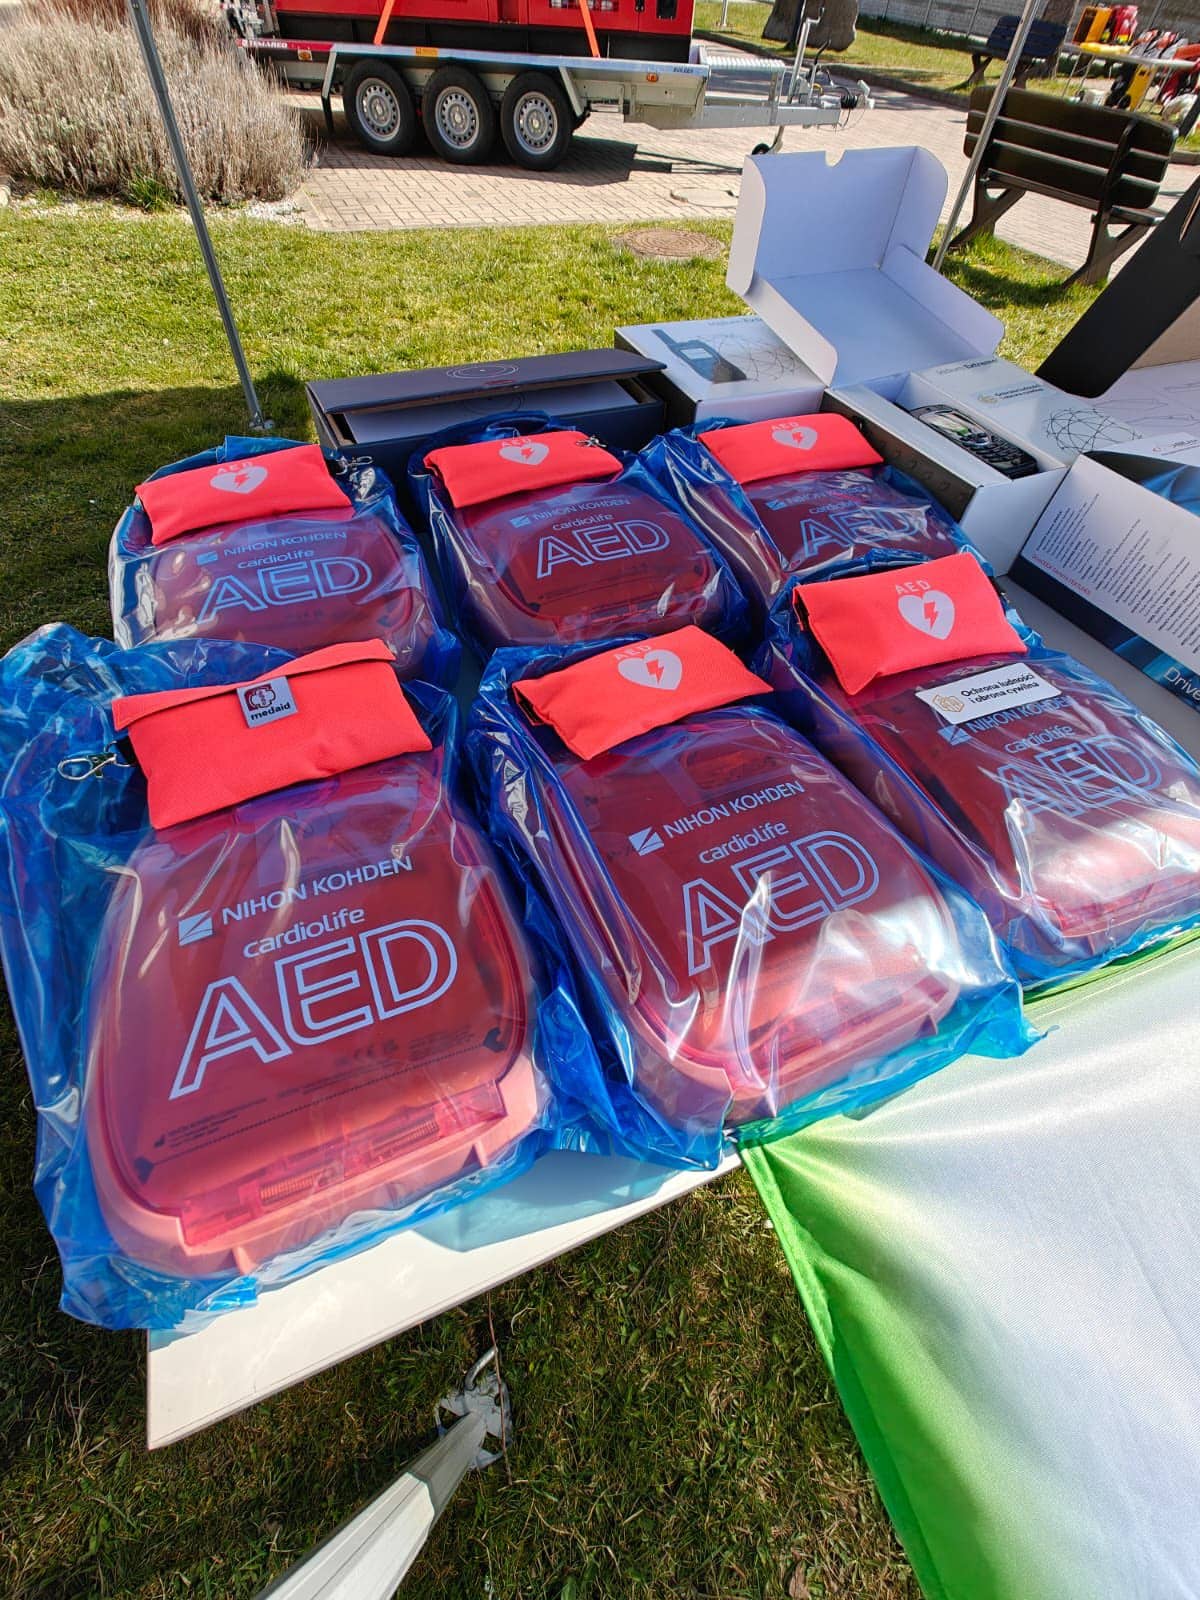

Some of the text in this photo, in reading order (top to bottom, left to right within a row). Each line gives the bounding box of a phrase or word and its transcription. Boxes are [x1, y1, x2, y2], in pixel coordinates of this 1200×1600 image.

[771, 422, 799, 430] AED
[217, 461, 253, 473] AED
[533, 496, 631, 520] NIHON KOHDEN
[224, 531, 347, 556] NIHON KOHDEN
[800, 509, 918, 558] AED
[536, 519, 670, 579] AED
[197, 557, 372, 625] AED
[895, 580, 931, 595] AED
[614, 645, 651, 660] AED
[960, 673, 1034, 697] Ochrona ludności
[974, 691, 1007, 703] obrona
[1007, 682, 1039, 696] cywilna
[251, 702, 290, 720] medaid
[966, 710, 1020, 733] NIHON
[997, 734, 1162, 834] AED
[663, 780, 805, 839] NIHON KOHDEN
[222, 855, 413, 925] NIHON KOHDEN
[682, 830, 880, 976] AED
[168, 919, 458, 1101] AED
